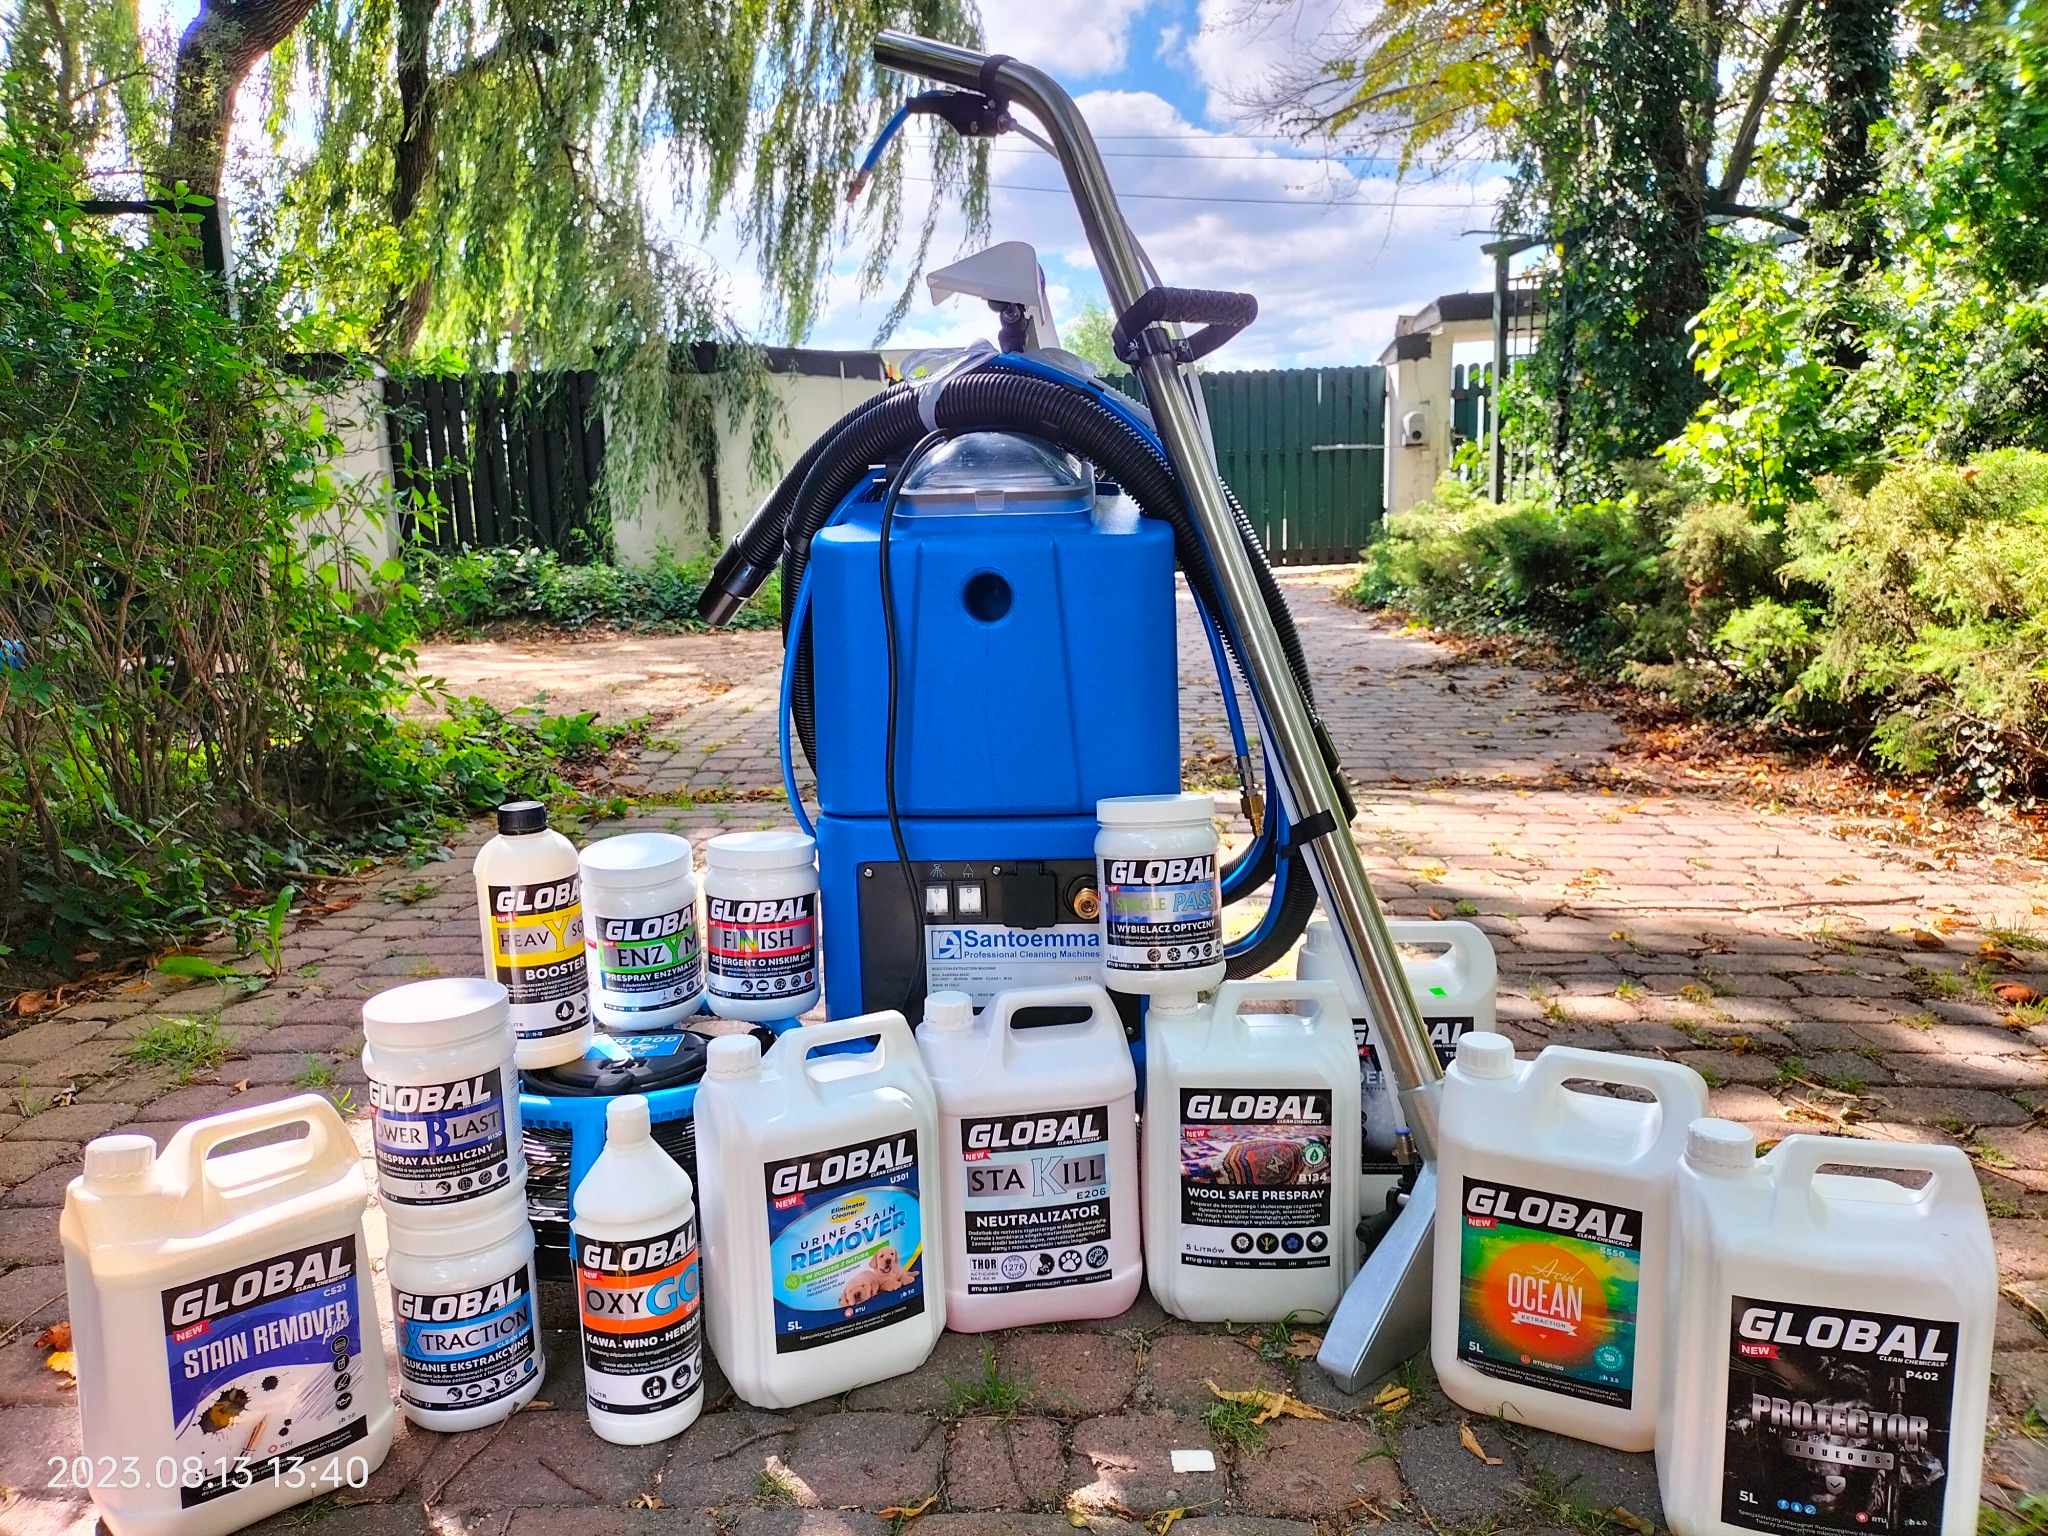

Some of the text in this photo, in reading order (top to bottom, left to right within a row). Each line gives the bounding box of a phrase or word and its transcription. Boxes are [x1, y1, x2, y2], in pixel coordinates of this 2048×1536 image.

[1110, 856, 1215, 885] GLOBAL
[496, 882, 581, 913] GLOBA
[1116, 888, 1214, 913] SINGLE PASS
[710, 896, 808, 923] GLOBAL
[496, 915, 512, 923] NEW
[1116, 919, 1215, 934] WYBIELACZ OPTYCZNY
[500, 914, 584, 954] HEAVY SO
[723, 927, 794, 955] FINISH
[964, 929, 1100, 948] Santoemma
[711, 951, 811, 968] DETERGENT O NISKIM pH
[964, 950, 1101, 960] Professional Cleaning Machines
[525, 956, 586, 981] BOOSTER
[606, 973, 652, 982] PRESPRAY
[654, 954, 702, 980] ENZYMATYC
[615, 1036, 679, 1044] RI-POD
[368, 1076, 492, 1113] GLOBAL
[1186, 1095, 1323, 1120] GLOBAL
[377, 1109, 499, 1151] OWER BLAST
[967, 1114, 1100, 1149] GLOBAL
[1186, 1129, 1206, 1138] NEW
[377, 1142, 494, 1167] PRESPRAY ALKALICZNY
[965, 1151, 985, 1161] NEW
[771, 1138, 914, 1196] GLOBAL
[870, 1168, 887, 1178] CLEAN
[889, 1171, 910, 1184] U301
[1298, 1172, 1328, 1183] B134
[1076, 1187, 1107, 1200] E206
[1187, 1187, 1325, 1201] WOOL SAFE PRESPRAY
[775, 1196, 797, 1209] NEW
[830, 1200, 867, 1214] Eliminator
[831, 1209, 858, 1221] Cleaner
[975, 1205, 1100, 1228] NEUTRALIZATOR
[1466, 1186, 1634, 1243] GLOBAL
[1468, 1217, 1491, 1228] NEW
[800, 1204, 897, 1250] URINE STAIN
[789, 1209, 907, 1272] REMOVER
[1576, 1232, 1597, 1241] CLEAN
[583, 1223, 697, 1272] GLOBAL
[1599, 1246, 1626, 1258] S550
[805, 1273, 814, 1281] W
[813, 1264, 841, 1277] ZGODZIE
[971, 1258, 998, 1271] THOR
[1003, 1262, 1025, 1273] 1276
[1526, 1258, 1585, 1283] Acid
[582, 1270, 598, 1280] NEW
[171, 1246, 352, 1327] GLOBAL
[295, 1281, 316, 1293] CLEAN
[322, 1282, 348, 1298] C521
[586, 1262, 700, 1316] OXYGO
[398, 1275, 522, 1322] GLOBAL
[1507, 1272, 1583, 1323] OCEAN
[321, 1313, 353, 1345] plus
[786, 1320, 803, 1332] 5L
[1521, 1314, 1567, 1329] EXTRACTION
[175, 1324, 203, 1342] NEW
[183, 1299, 349, 1379] STAIN REMOVER
[586, 1332, 617, 1349] KAWA
[622, 1336, 659, 1349] WINO
[665, 1312, 701, 1342] HERBAT
[1738, 1307, 1949, 1362] GLOBAL
[496, 1334, 519, 1349] CLEAN
[1468, 1340, 1484, 1354] 5L
[1741, 1344, 1770, 1356] NEW
[402, 1334, 529, 1373] PŁUKANIE EKSTRAKCYJNE
[1878, 1354, 1904, 1364] CLEAN
[1905, 1369, 1939, 1382] P402
[1751, 1392, 1929, 1446] PROTECTOR
[279, 1440, 294, 1449] RTU
[1795, 1440, 1882, 1465] AQUEOUS
[1738, 1489, 1759, 1505] 5L
[1871, 1516, 1888, 1525] RTU
